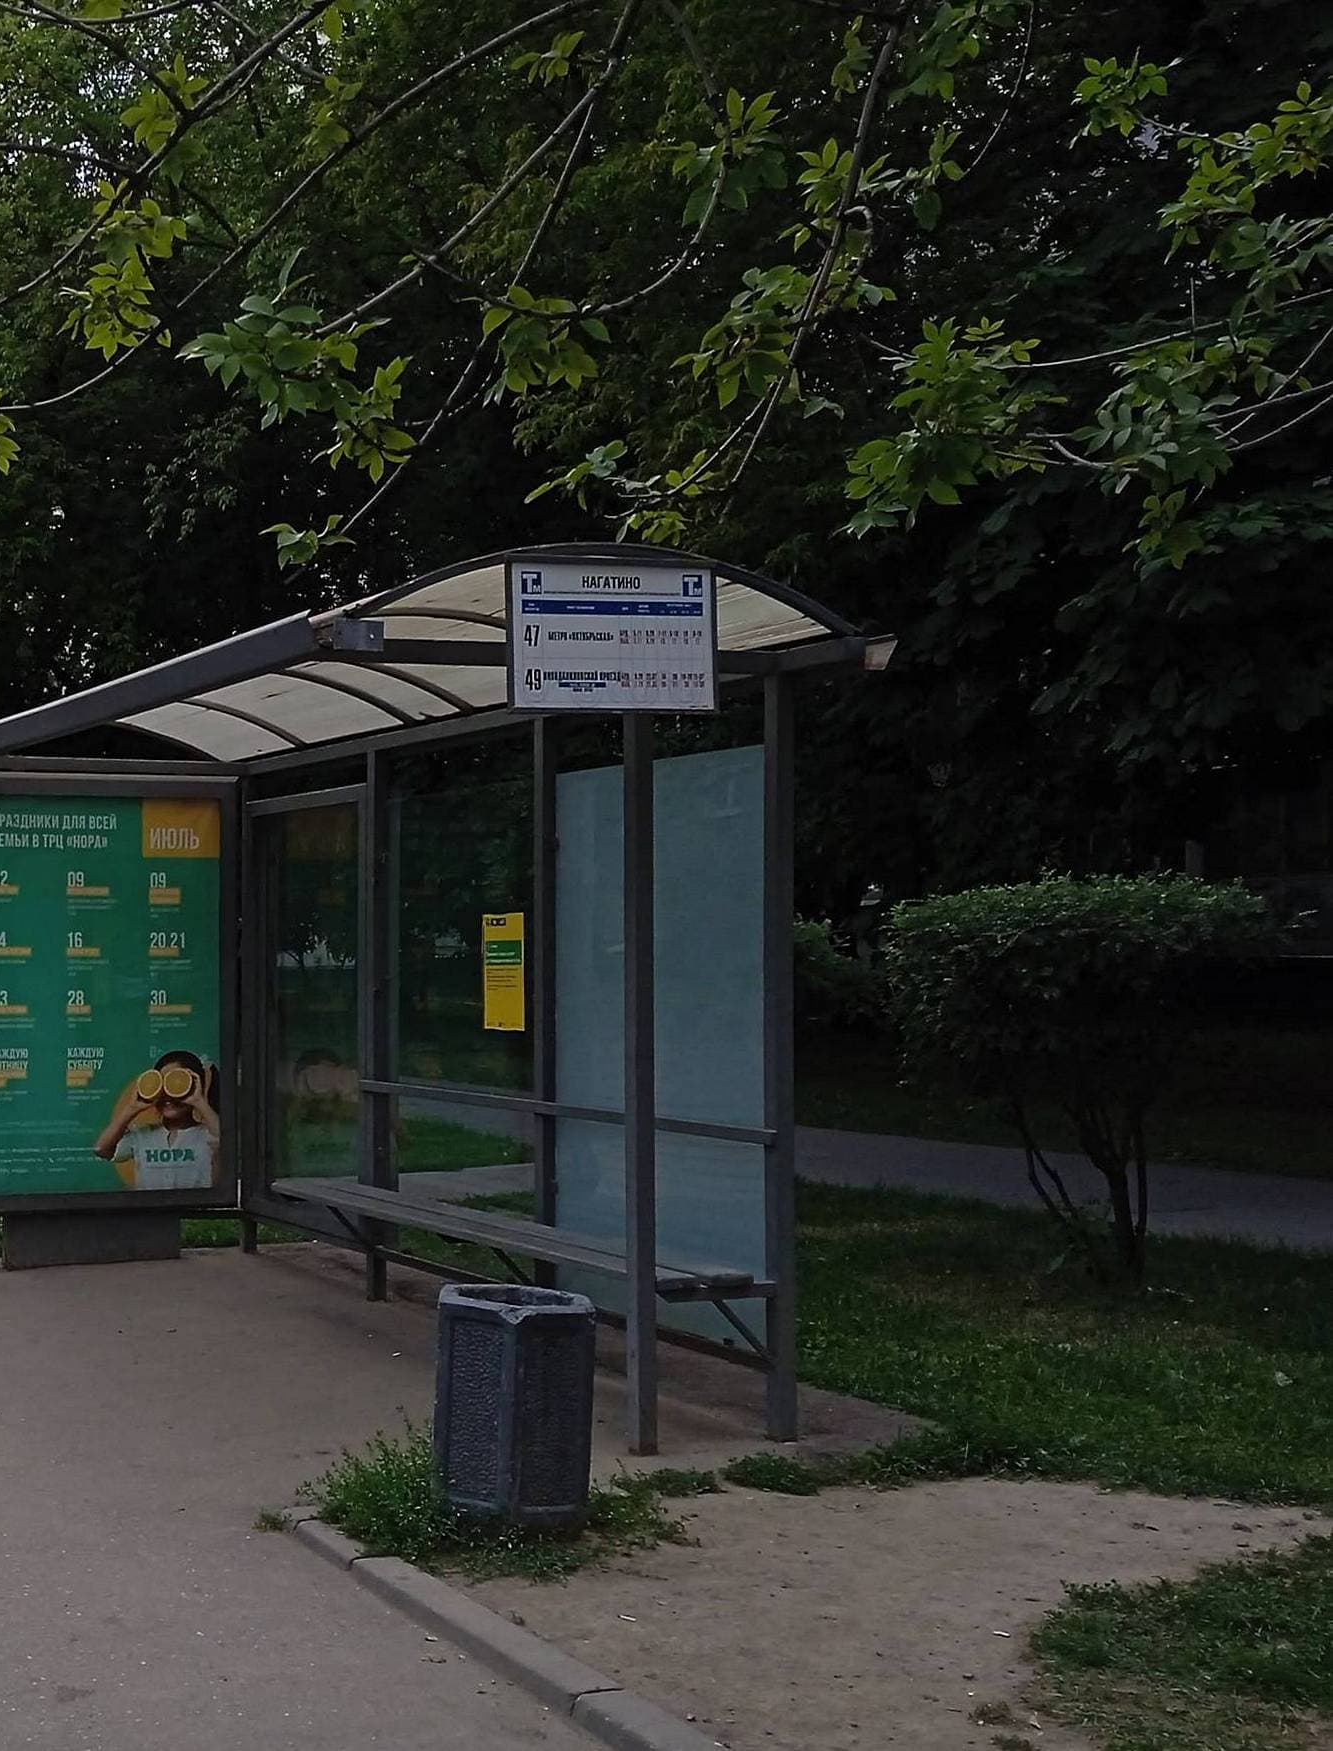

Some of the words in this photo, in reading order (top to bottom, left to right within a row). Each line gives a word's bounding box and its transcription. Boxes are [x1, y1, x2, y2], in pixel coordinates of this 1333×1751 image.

[582, 575, 641, 590] НАГАТИНО
[524, 624, 540, 647] 47
[525, 668, 542, 691] 49
[62, 814, 86, 831] ДЛЯ
[88, 813, 117, 830] ВСЕЙ
[32, 833, 39, 848] В
[42, 834, 65, 850] ТРЦ
[150, 828, 200, 850] ИЮЛЬ
[67, 871, 84, 887] 09
[150, 872, 166, 888] 09
[67, 932, 83, 948] 16
[67, 990, 84, 1006] 28
[150, 989, 166, 1006] 30
[67, 1047, 104, 1058] КАЖДУЮ
[145, 1148, 195, 1163] НОРА
